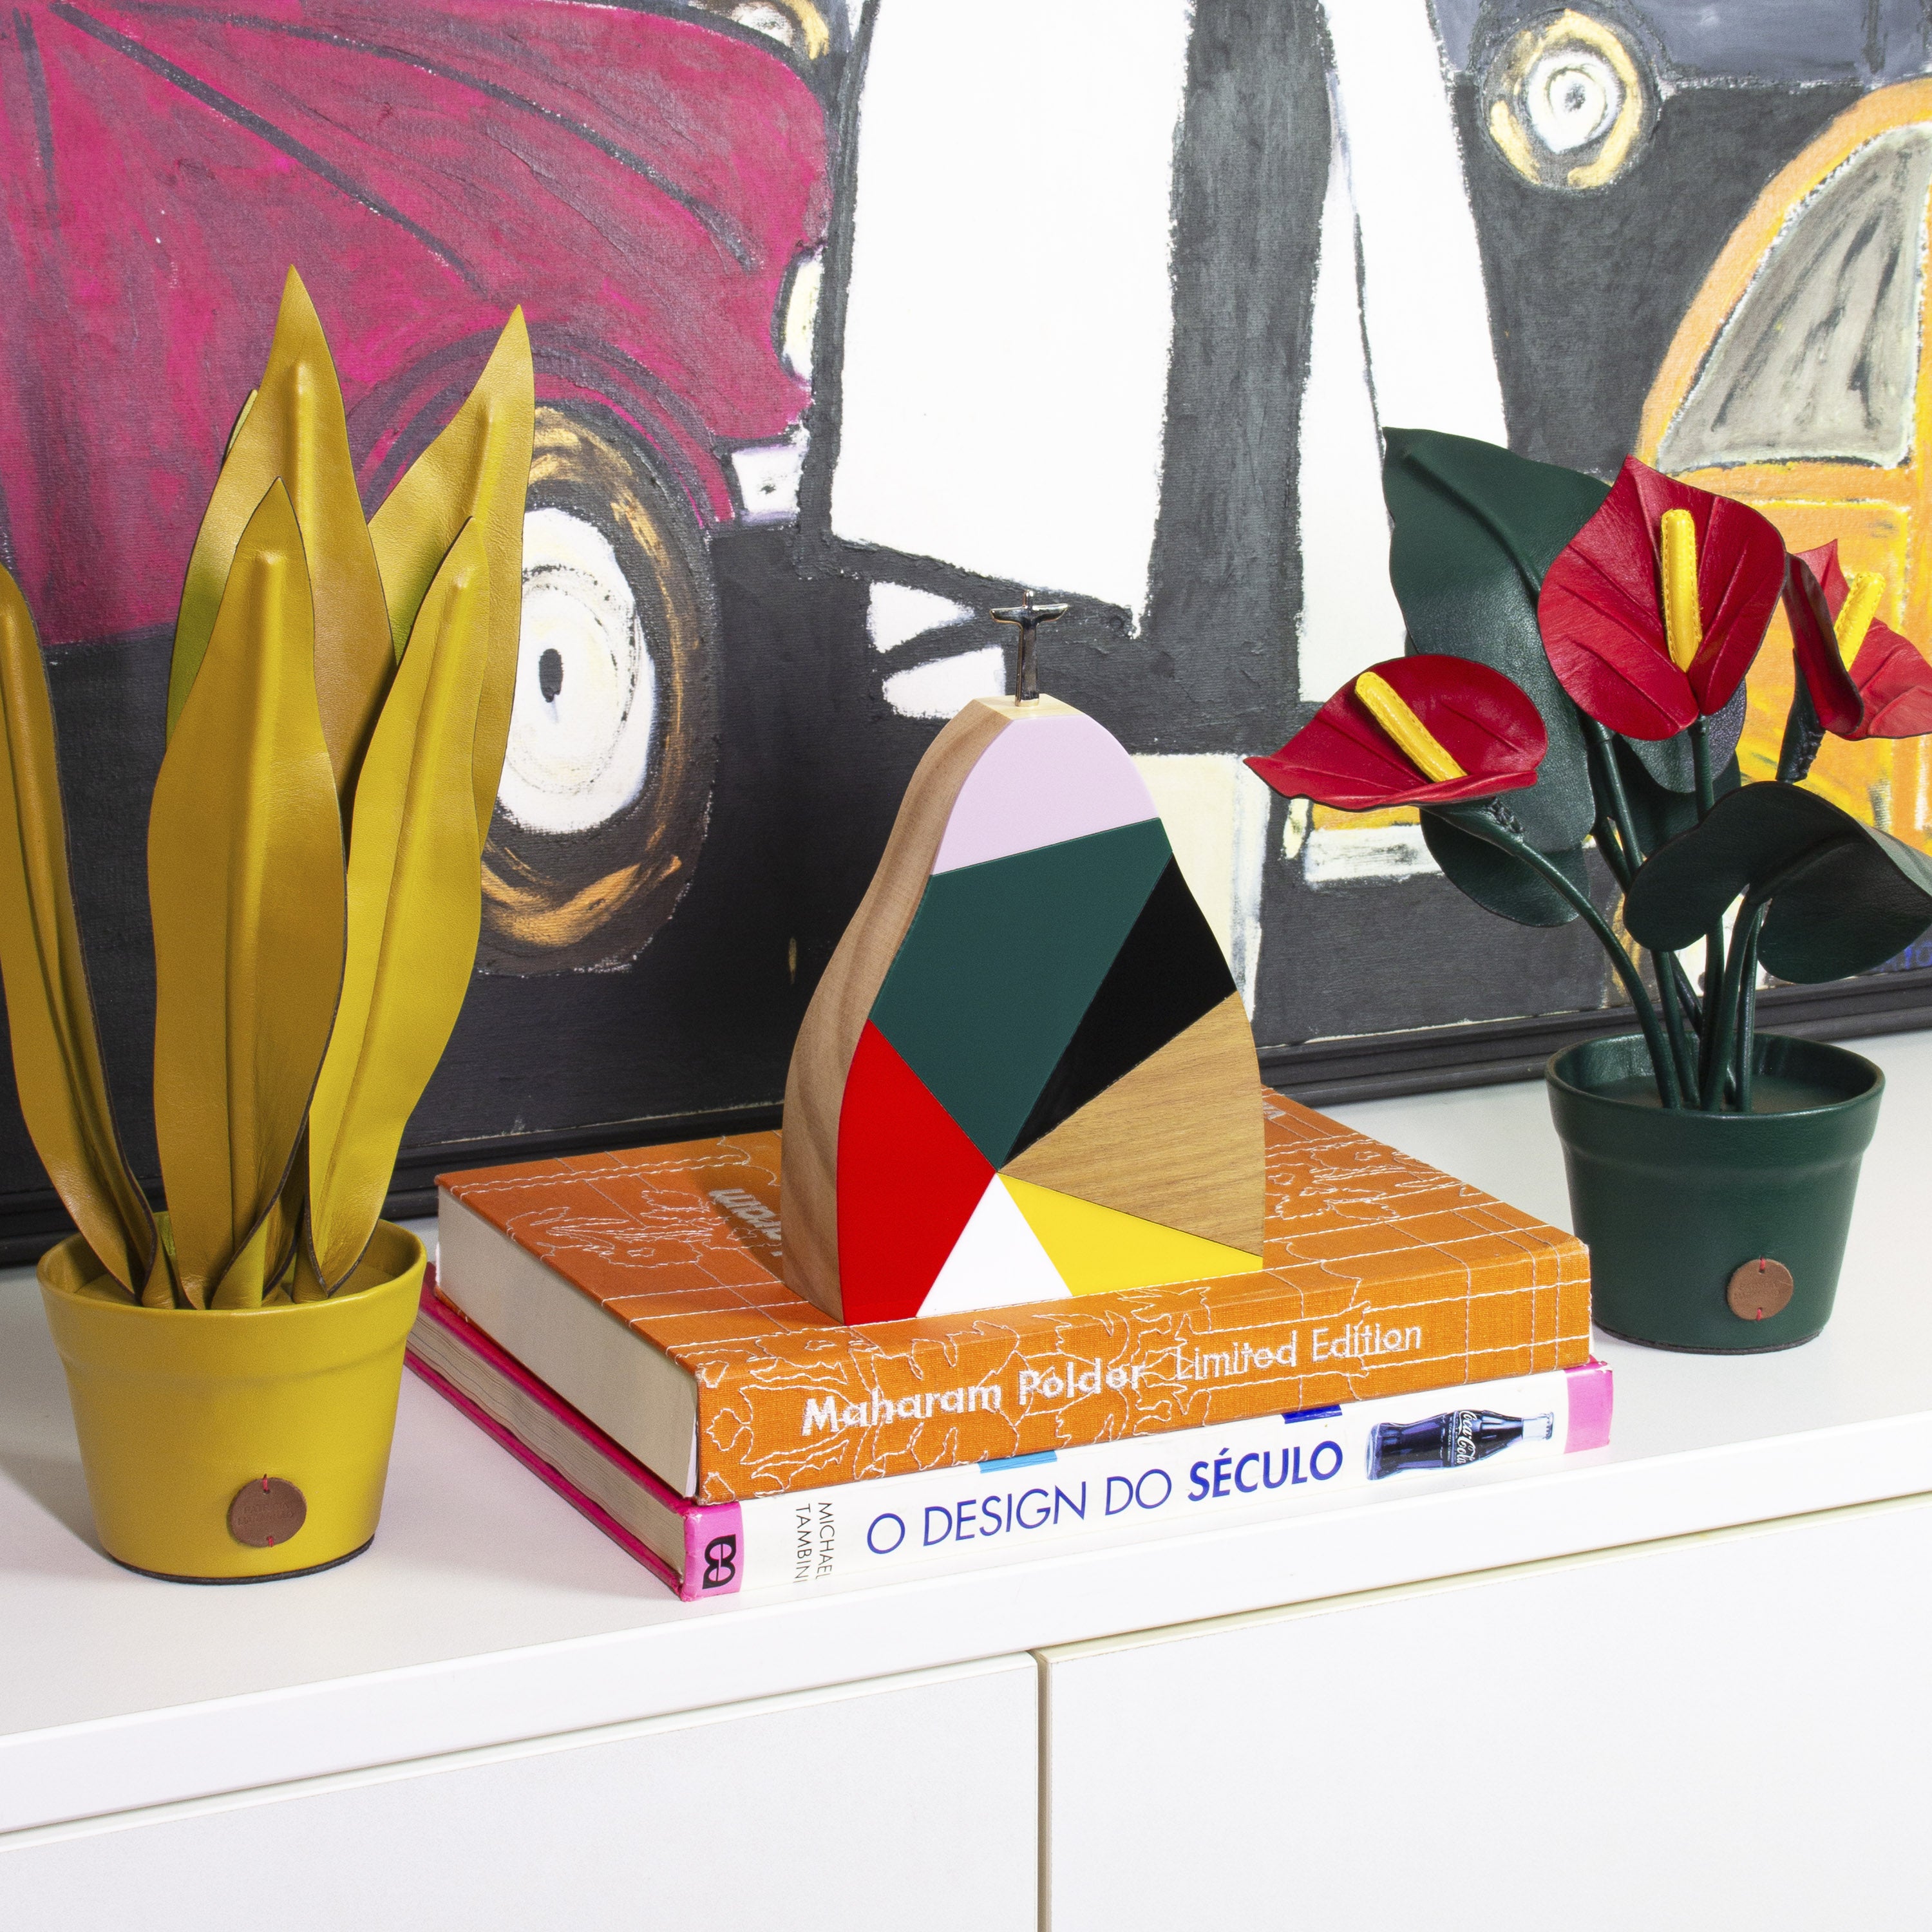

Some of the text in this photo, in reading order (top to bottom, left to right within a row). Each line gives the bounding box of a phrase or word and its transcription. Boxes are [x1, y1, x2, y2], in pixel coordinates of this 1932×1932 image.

[800, 1322, 1422, 1436] Maharam Polder Limited Edition
[1457, 1410, 1477, 1464] Coca-Cola
[866, 1440, 1343, 1555] O DESIGN DO SÉCULO
[793, 1502, 813, 1584] TAMBINI
[815, 1502, 835, 1580] MICHAEL
